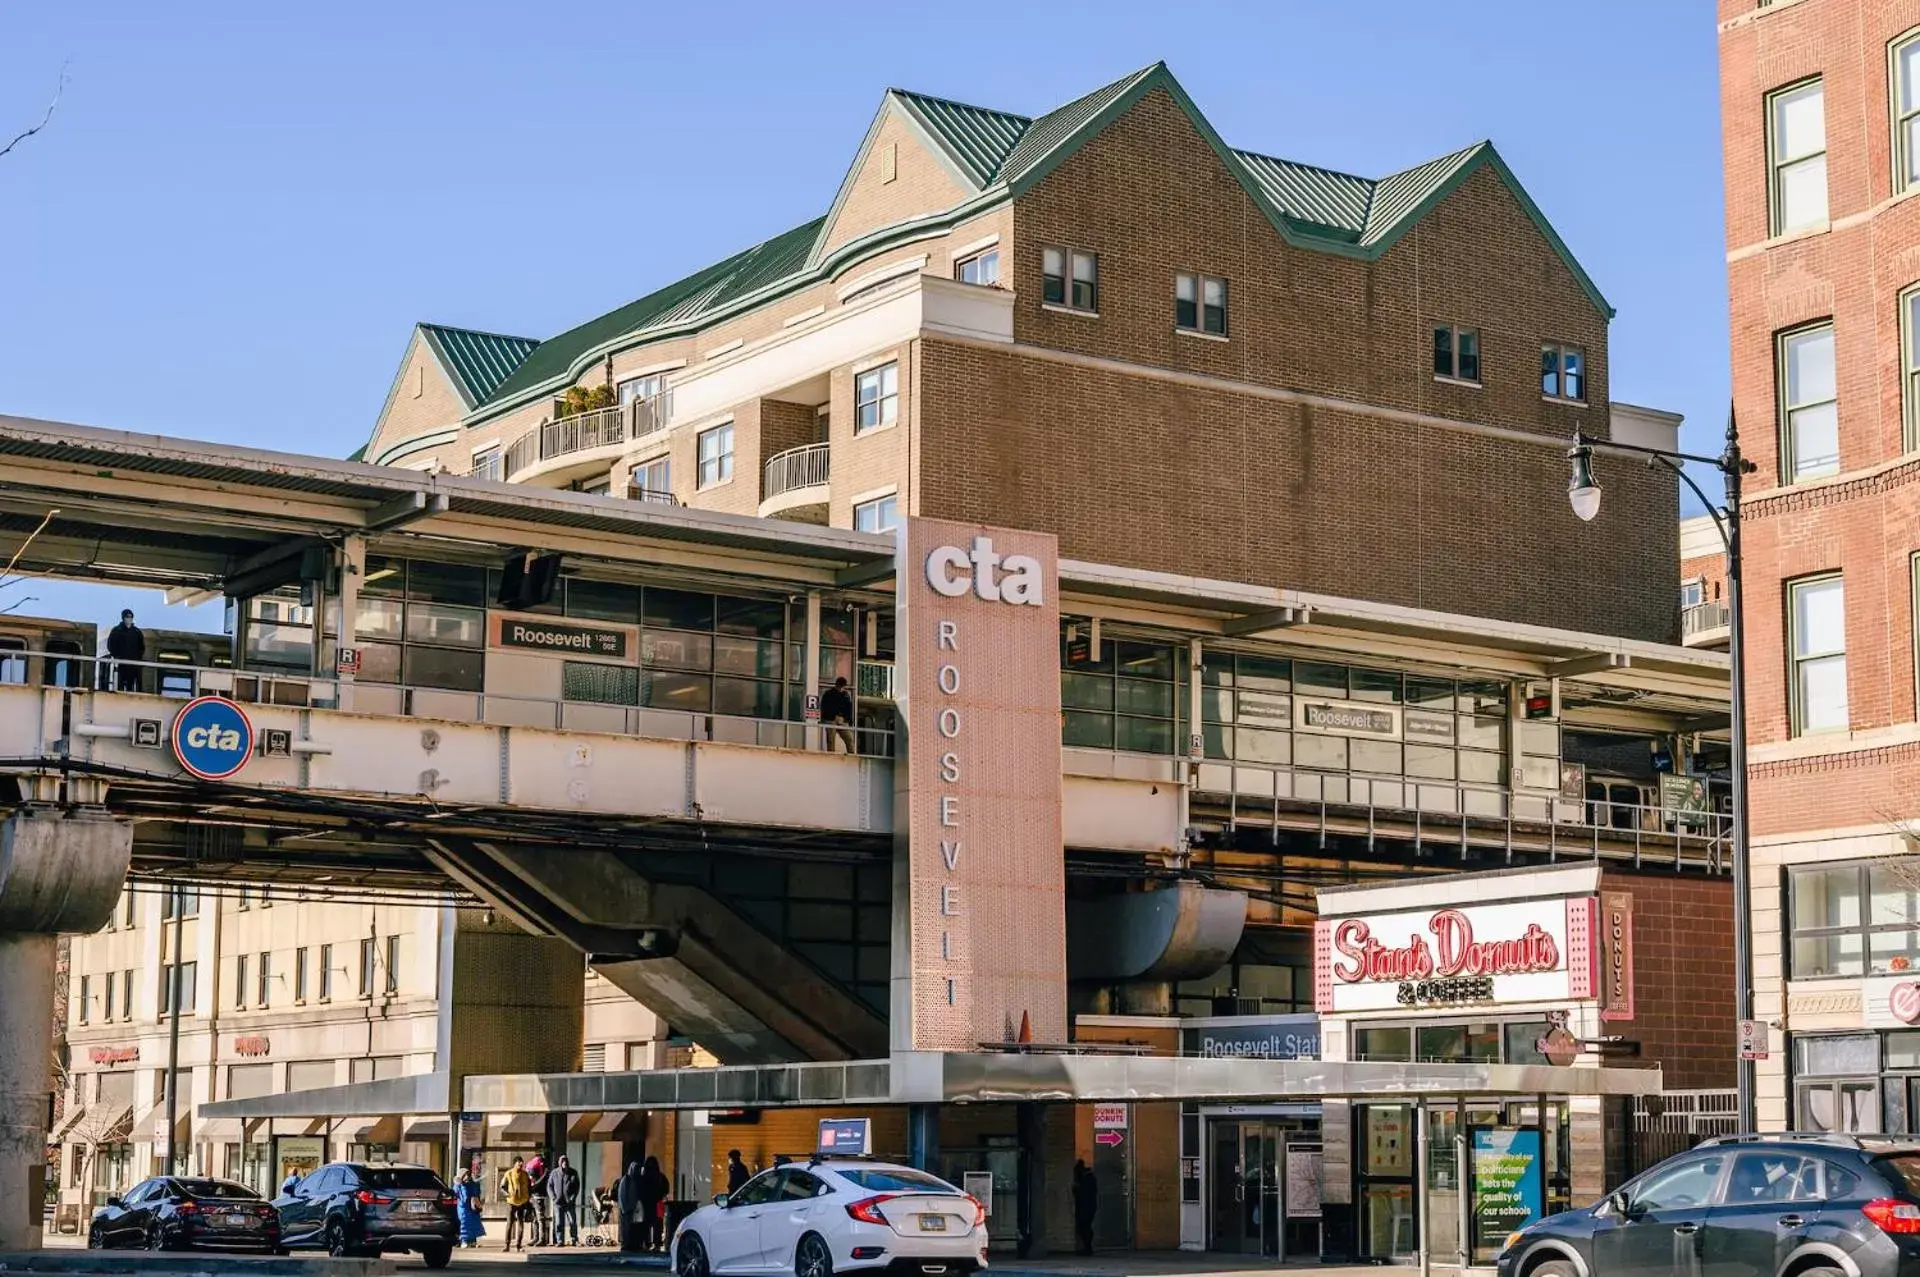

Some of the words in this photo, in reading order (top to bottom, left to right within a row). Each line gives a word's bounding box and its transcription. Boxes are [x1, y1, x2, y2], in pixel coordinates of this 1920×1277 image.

[925, 537, 1044, 606] cta
[513, 626, 591, 648] Roosevelt
[343, 650, 353, 662] R
[1308, 706, 1371, 728] Roosevelt
[187, 723, 240, 751] cta
[1429, 909, 1559, 976] Donuts
[1612, 912, 1622, 997] DONUTS
[1397, 982, 1416, 1004] &
[1203, 1035, 1280, 1058] Roosevelt
[1483, 1192, 1512, 1203] quality
[1514, 1192, 1522, 1201] of
[1499, 1206, 1531, 1215] schools
